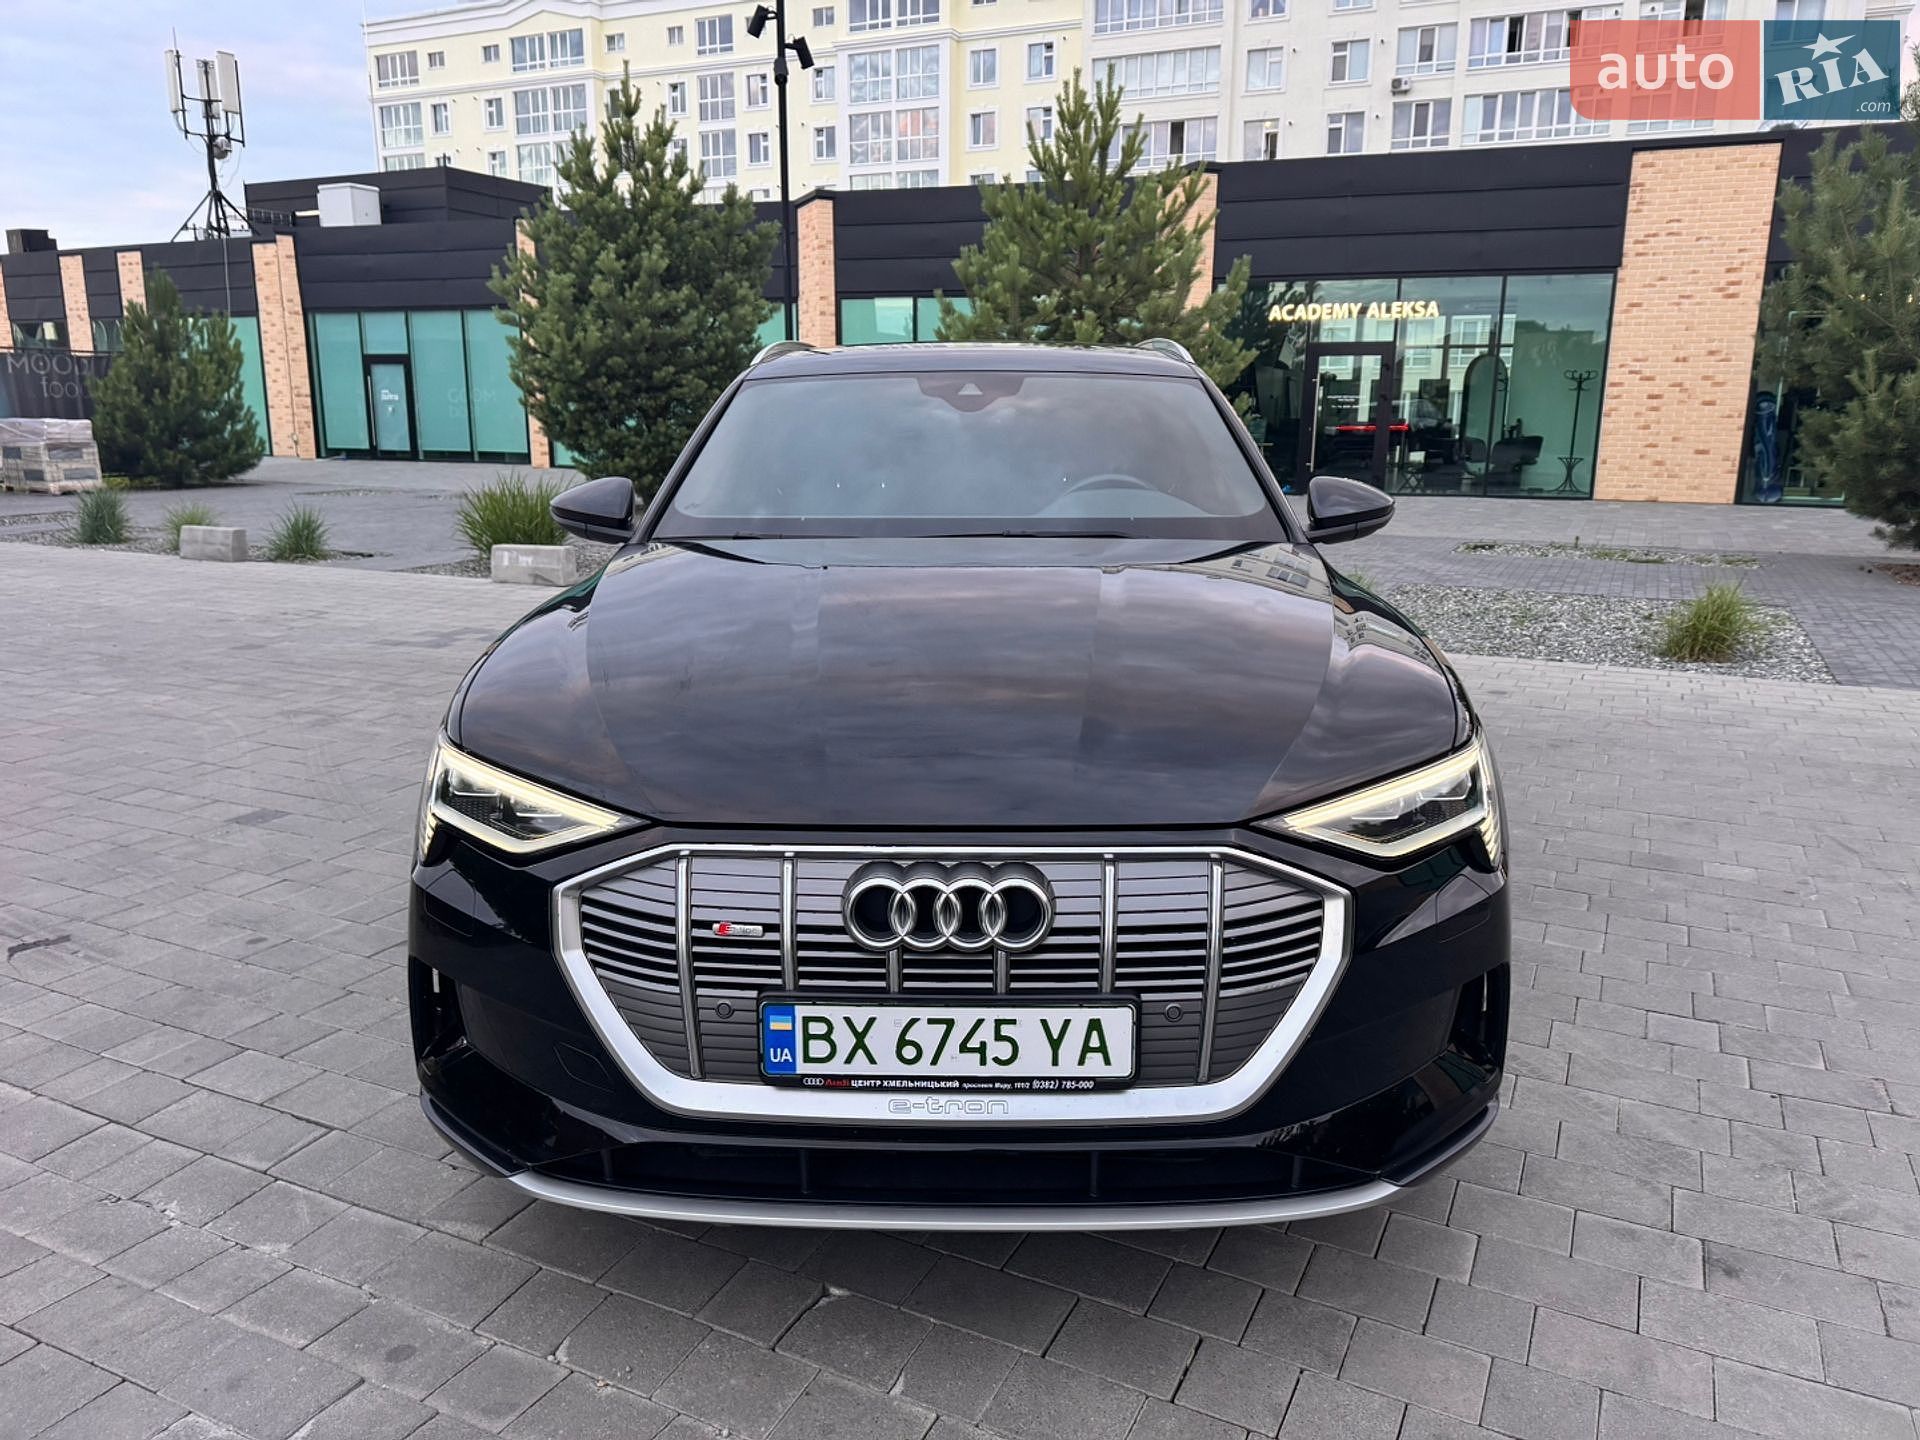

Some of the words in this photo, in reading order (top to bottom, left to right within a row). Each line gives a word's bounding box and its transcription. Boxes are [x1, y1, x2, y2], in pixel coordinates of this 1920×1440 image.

[1268, 302, 1362, 322] ACADEMY
[1366, 300, 1440, 320] ALEKSA
[801, 1015, 878, 1065] BX
[895, 1017, 1020, 1067] 6745
[1039, 1018, 1113, 1067] YA
[769, 1047, 793, 1063] UA
[851, 1080, 882, 1089] ЦЕНТР
[883, 1079, 960, 1090] ХМЕЛЬНИЦЬКИЙ
[888, 1096, 1009, 1114] e-tron
